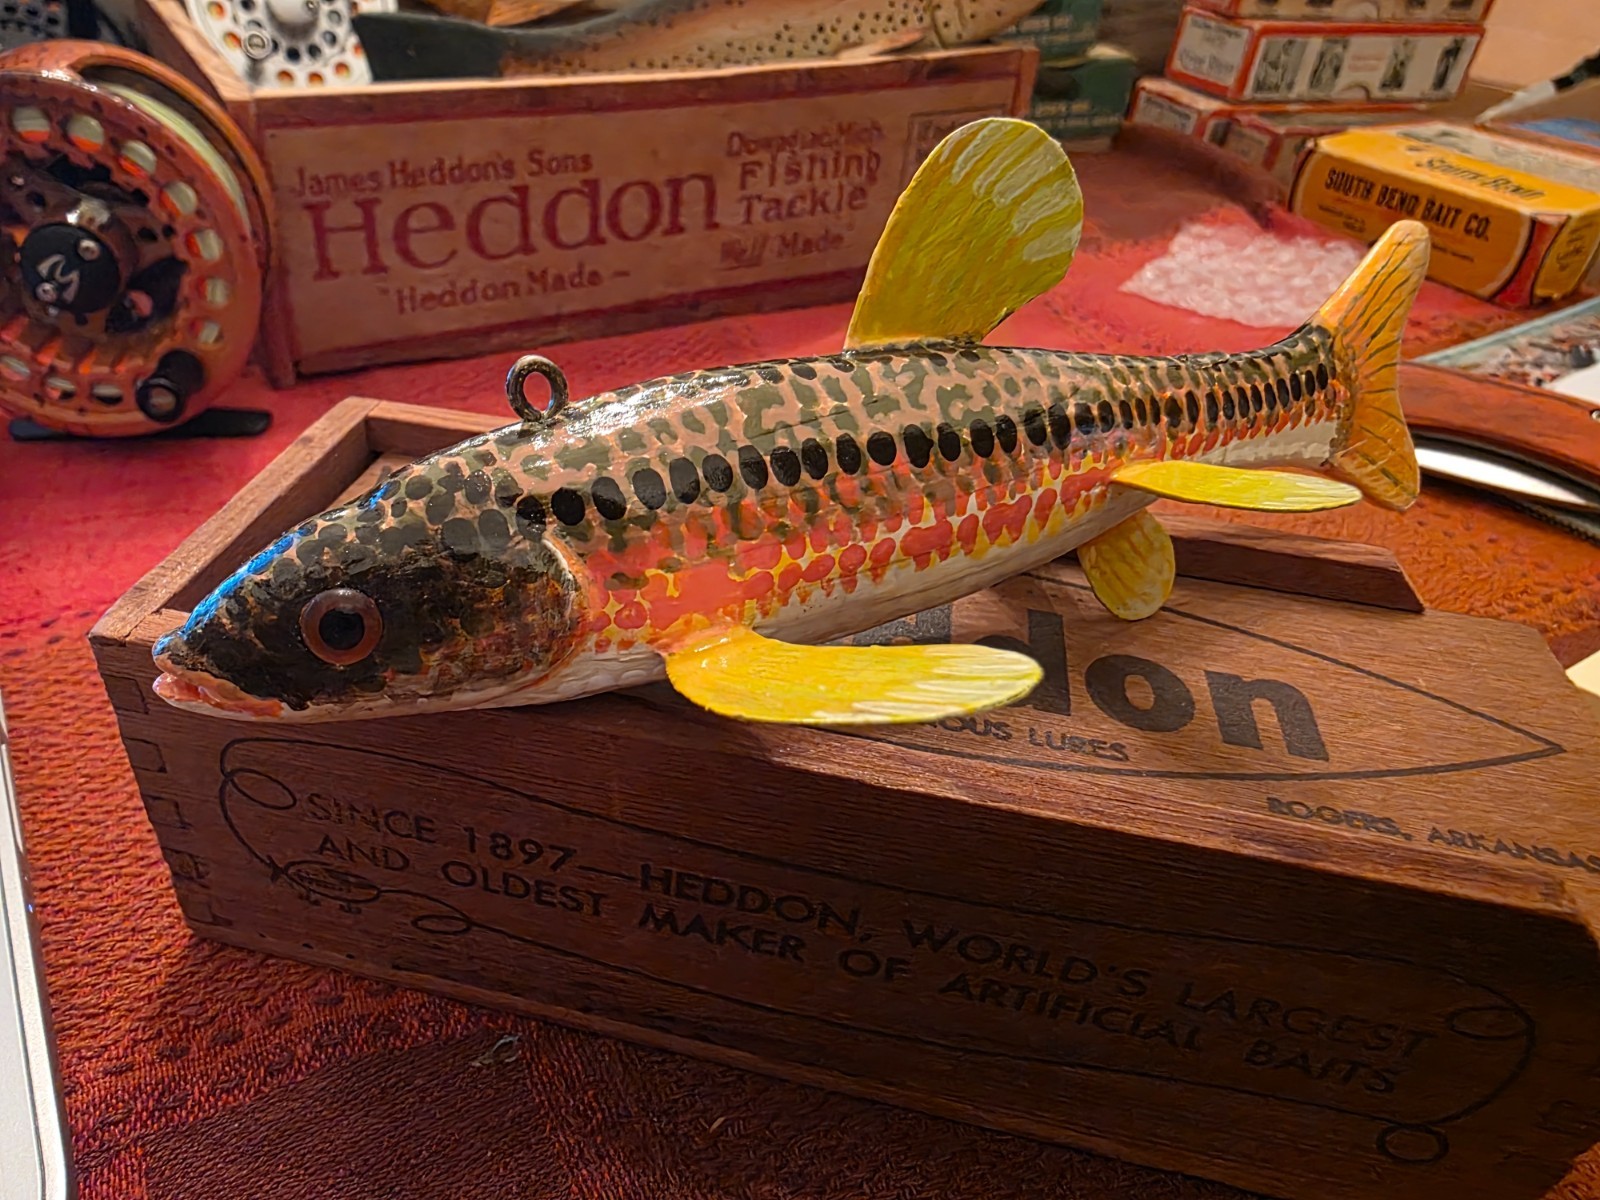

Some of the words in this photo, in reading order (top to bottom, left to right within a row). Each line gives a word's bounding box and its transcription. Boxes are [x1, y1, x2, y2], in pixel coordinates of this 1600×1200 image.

[291, 165, 382, 198] James
[388, 150, 516, 189] Heddon's
[527, 148, 594, 178] Sons
[738, 147, 882, 191] Fishing
[303, 173, 719, 281] Heddon
[736, 181, 869, 225] Tackle
[1324, 167, 1376, 200] SOUTH
[1375, 184, 1420, 216] BEND
[1420, 197, 1463, 229] BAIT
[1463, 211, 1492, 243] CO.
[395, 277, 522, 316] Heddon
[527, 260, 604, 295] Made
[306, 791, 438, 844] SINCE
[463, 826, 578, 874] 1897
[638, 863, 873, 941] HEDDON,
[901, 917, 1152, 999] WORLD'S
[1176, 981, 1440, 1059] LARGEST
[316, 833, 412, 874] AND
[440, 860, 610, 918] OLDEST
[637, 902, 807, 963] MAKER
[836, 948, 914, 983] OF
[937, 971, 1204, 1054] ARTIFICIAL
[1244, 1039, 1400, 1095] BAITS
